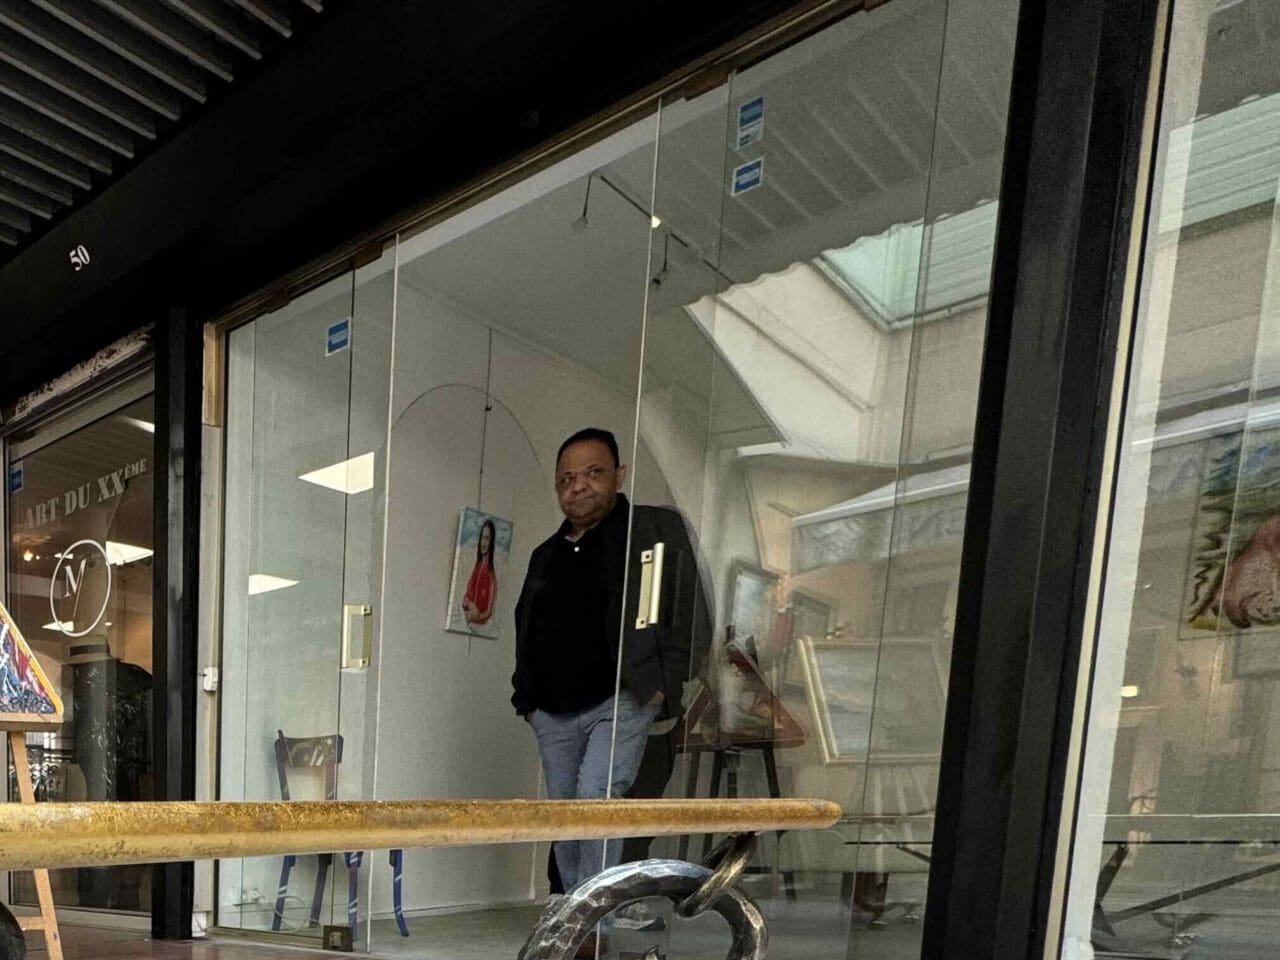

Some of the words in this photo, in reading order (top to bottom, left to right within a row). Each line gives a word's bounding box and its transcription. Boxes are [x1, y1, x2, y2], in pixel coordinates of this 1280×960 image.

[69, 244, 91, 272] 50
[26, 497, 59, 530] ART
[64, 483, 91, 516] DU
